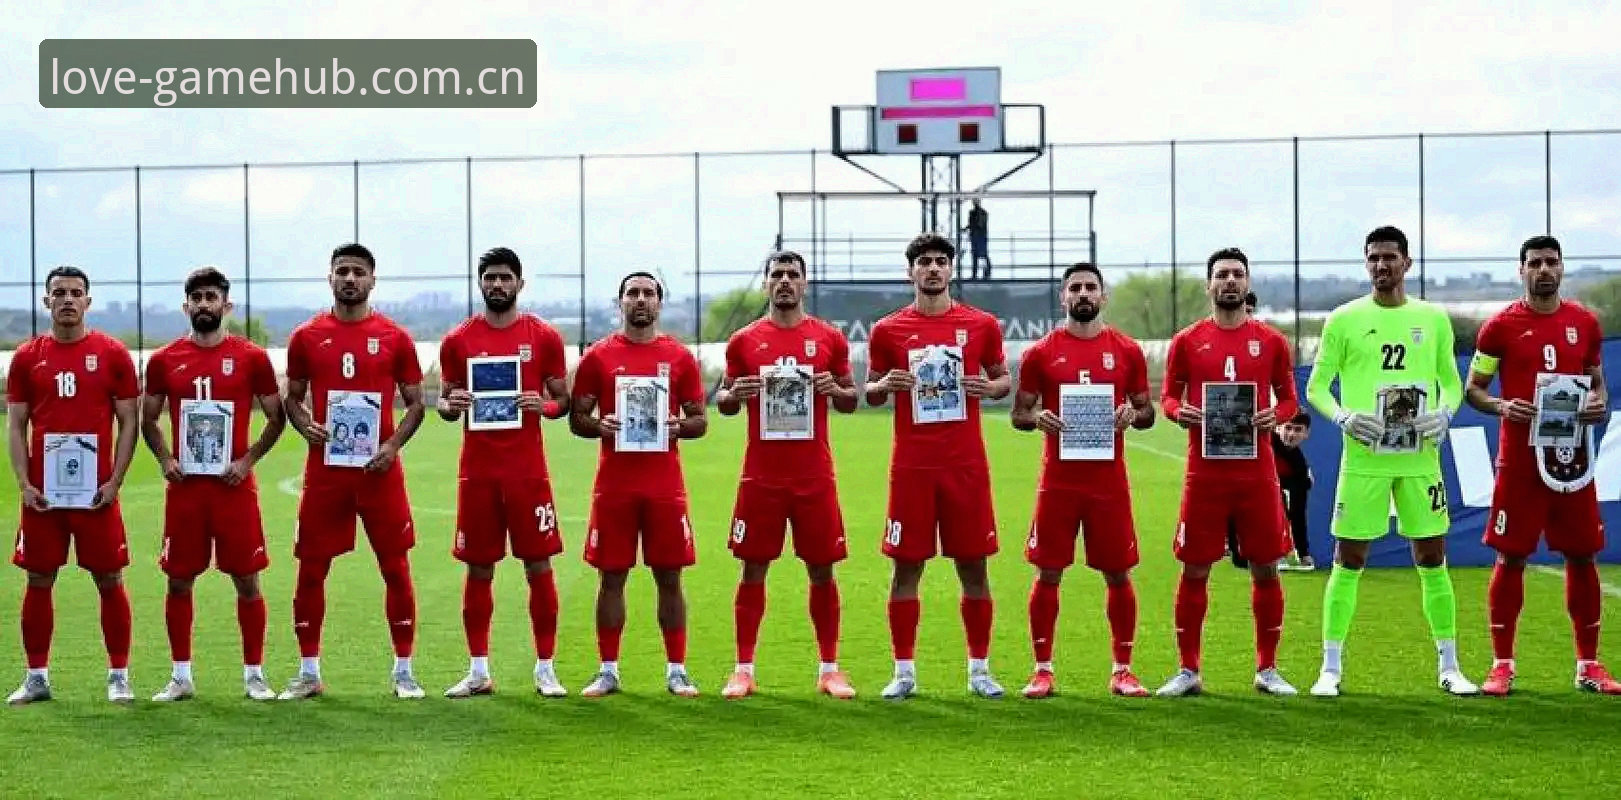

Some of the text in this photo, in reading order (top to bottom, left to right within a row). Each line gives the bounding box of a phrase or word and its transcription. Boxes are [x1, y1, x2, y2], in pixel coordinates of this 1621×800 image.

[342, 352, 355, 379] 8
[1223, 356, 1237, 382] 4
[1381, 344, 1406, 371] 22
[1543, 344, 1557, 371] 9
[55, 371, 76, 398] 18
[193, 376, 211, 401] 11
[1494, 510, 1506, 536] 9
